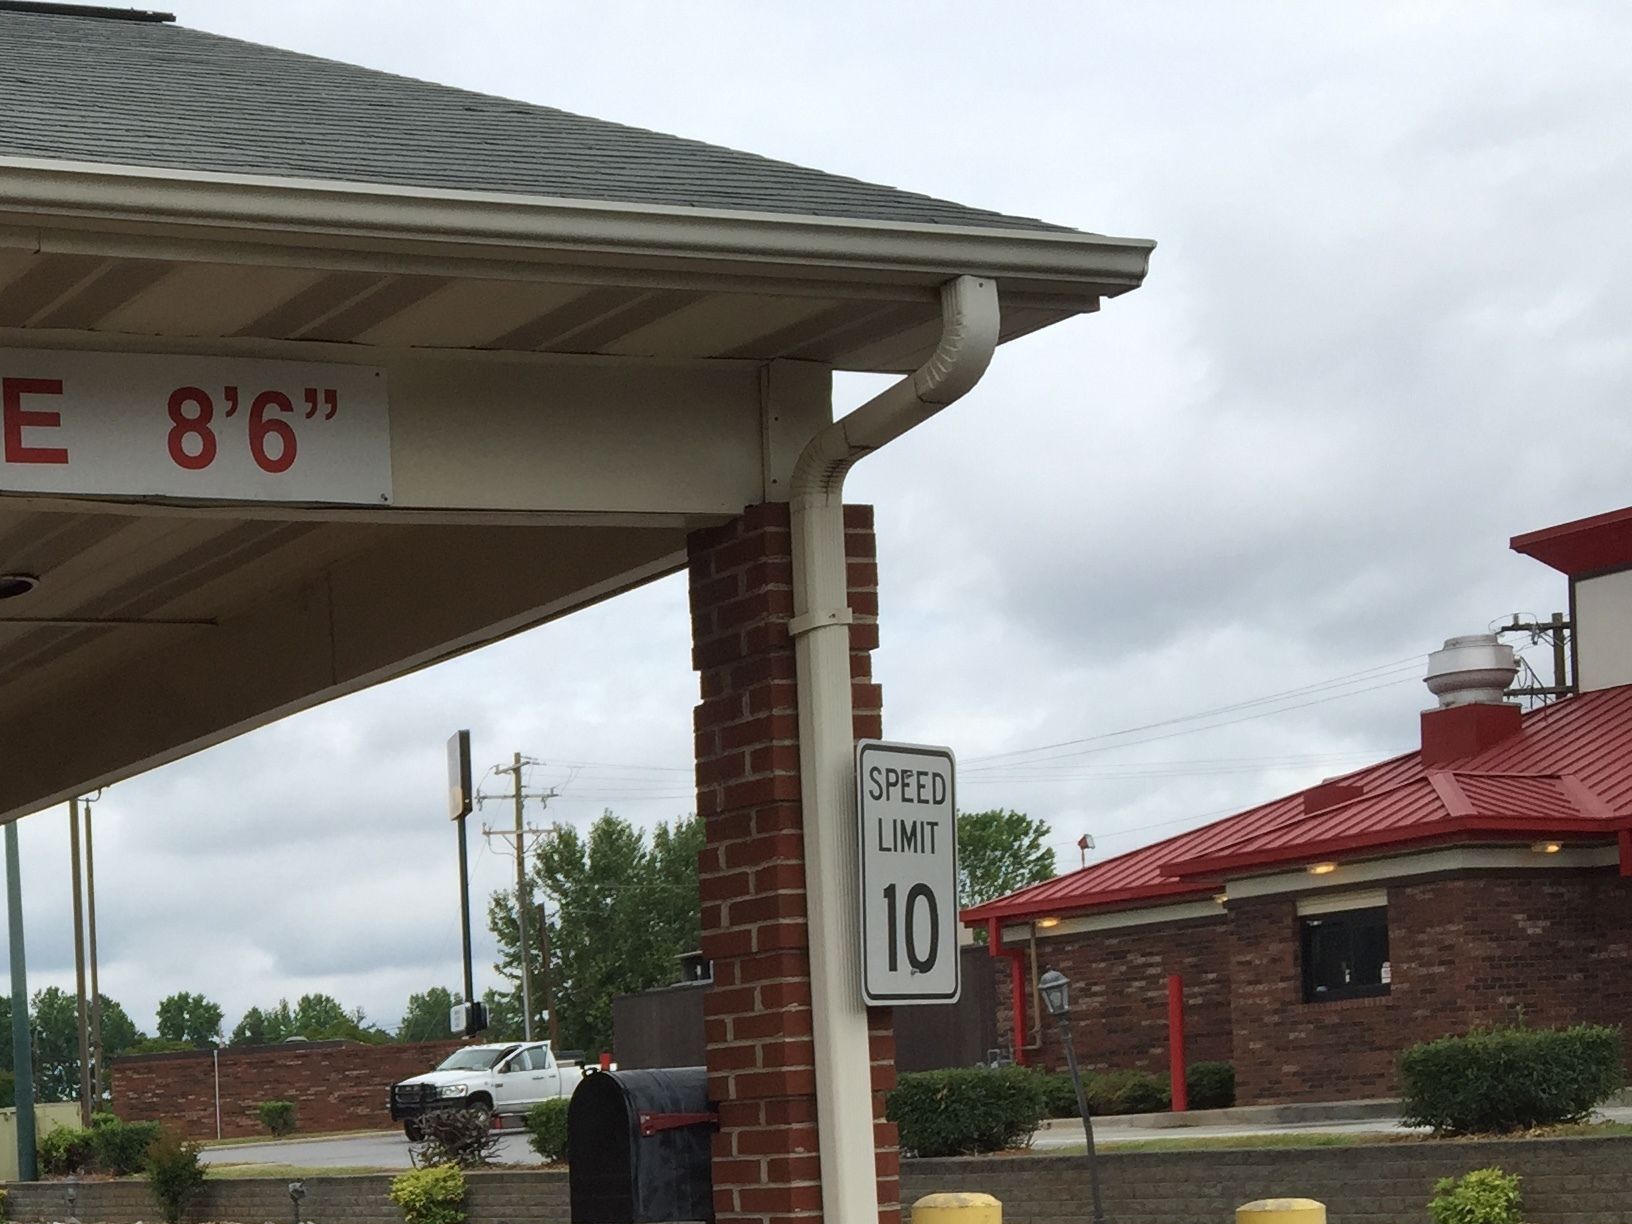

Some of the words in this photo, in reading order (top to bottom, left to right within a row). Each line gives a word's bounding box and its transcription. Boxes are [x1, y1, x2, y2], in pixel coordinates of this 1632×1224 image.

[868, 766, 946, 806] SPEED
[878, 817, 939, 854] LIMIT
[883, 882, 939, 974] 10
